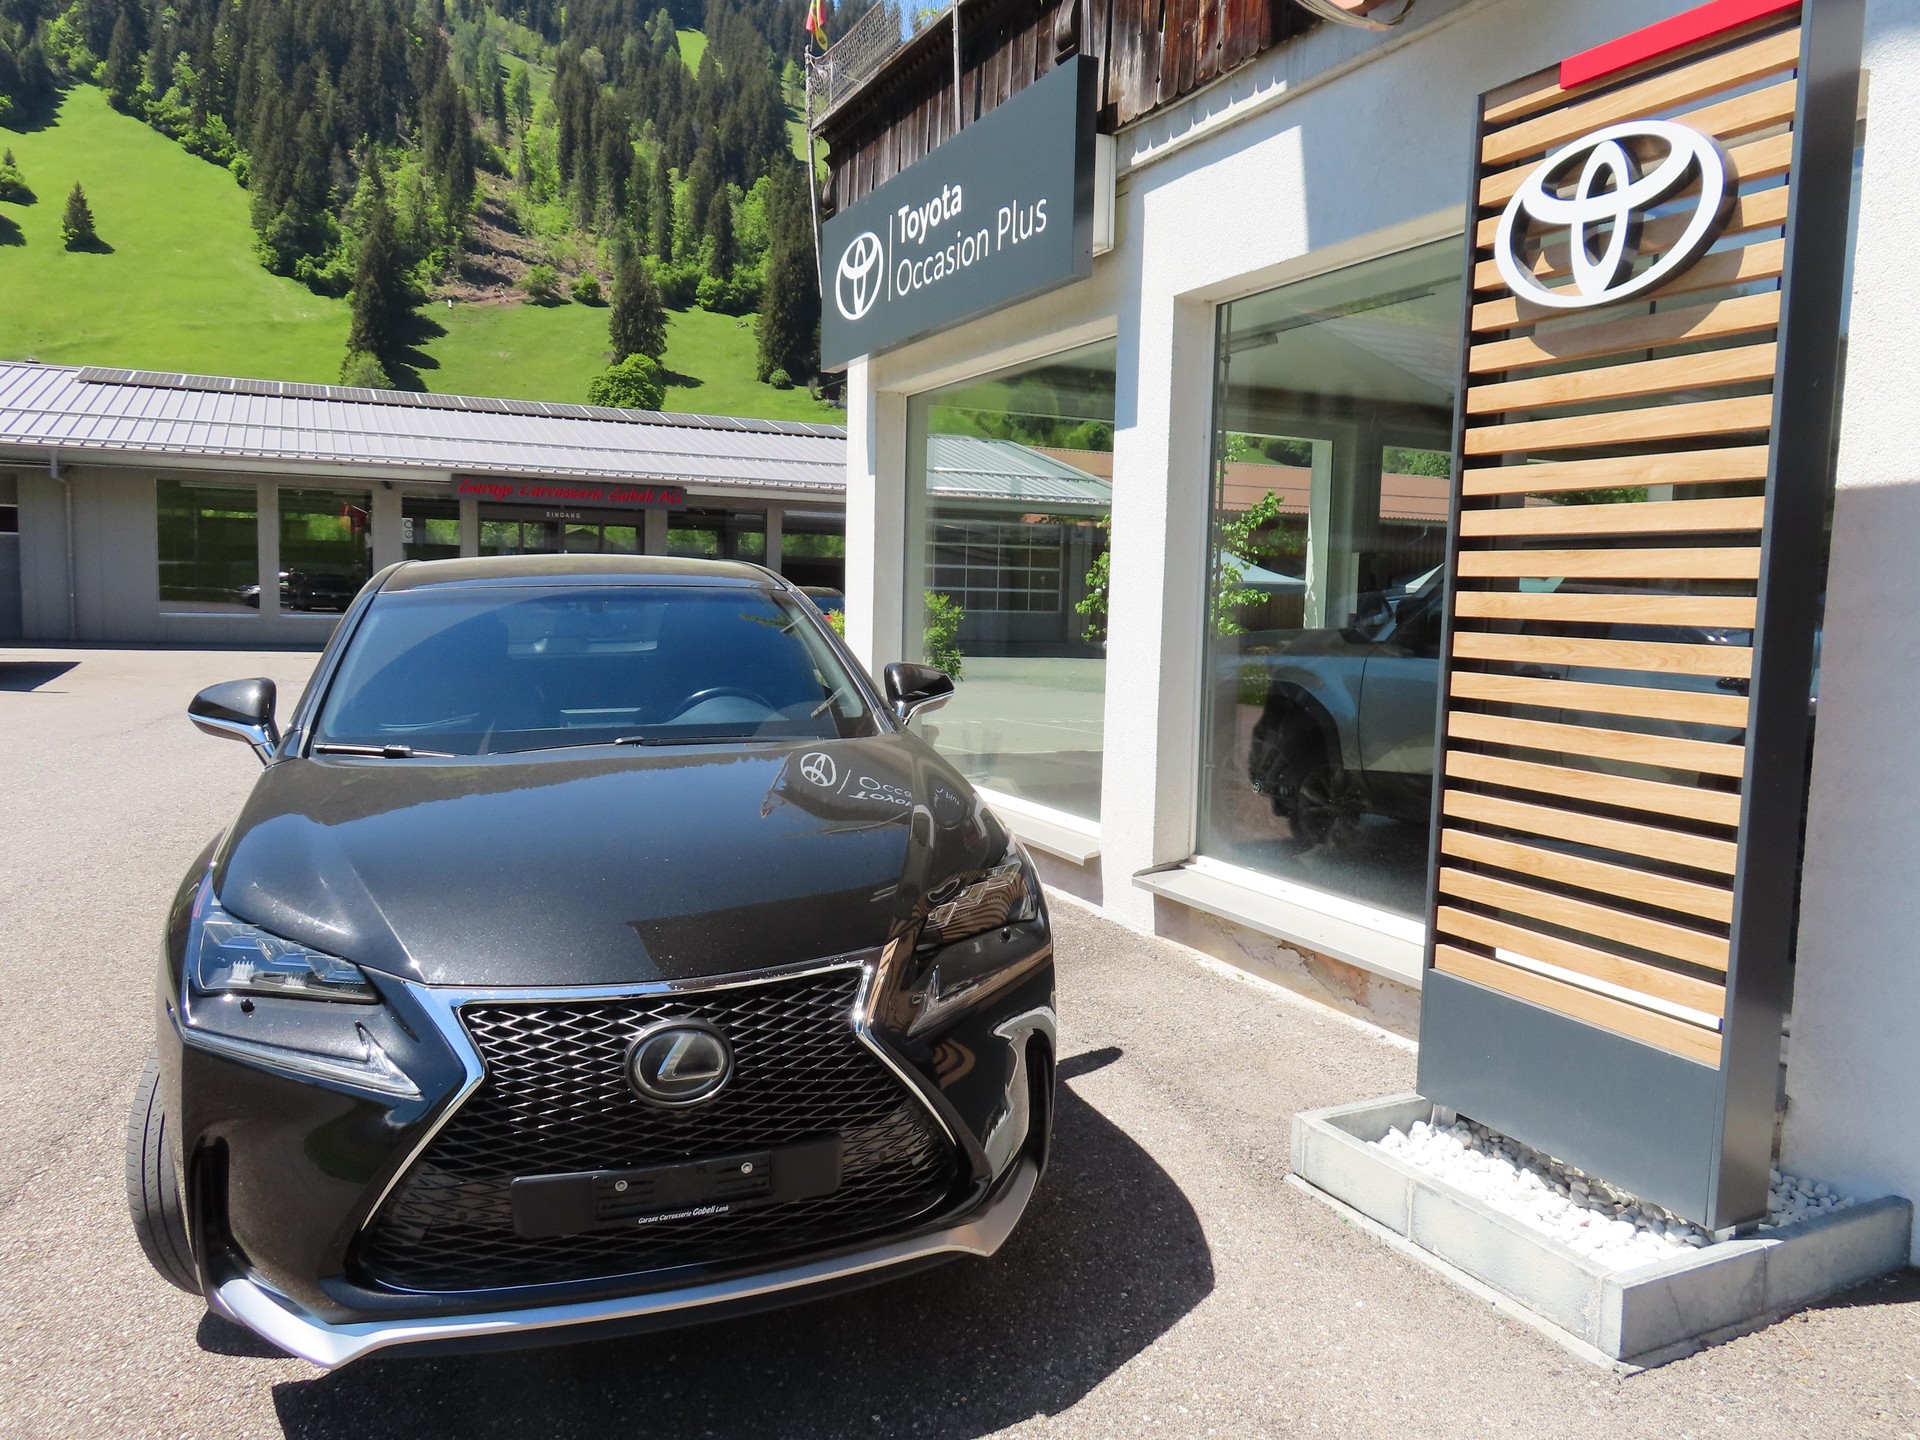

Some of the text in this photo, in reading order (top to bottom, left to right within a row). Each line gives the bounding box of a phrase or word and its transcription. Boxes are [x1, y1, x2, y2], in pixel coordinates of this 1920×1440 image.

[898, 183, 963, 245] Toyota
[896, 197, 1048, 296] Occasion Plus
[458, 479, 514, 501] Garage
[518, 483, 603, 501] Carrosserie
[657, 488, 685, 506] AG
[546, 511, 581, 519] EINGANG
[638, 1204, 729, 1225] Garage Carrosserie Gobeli Lenk
